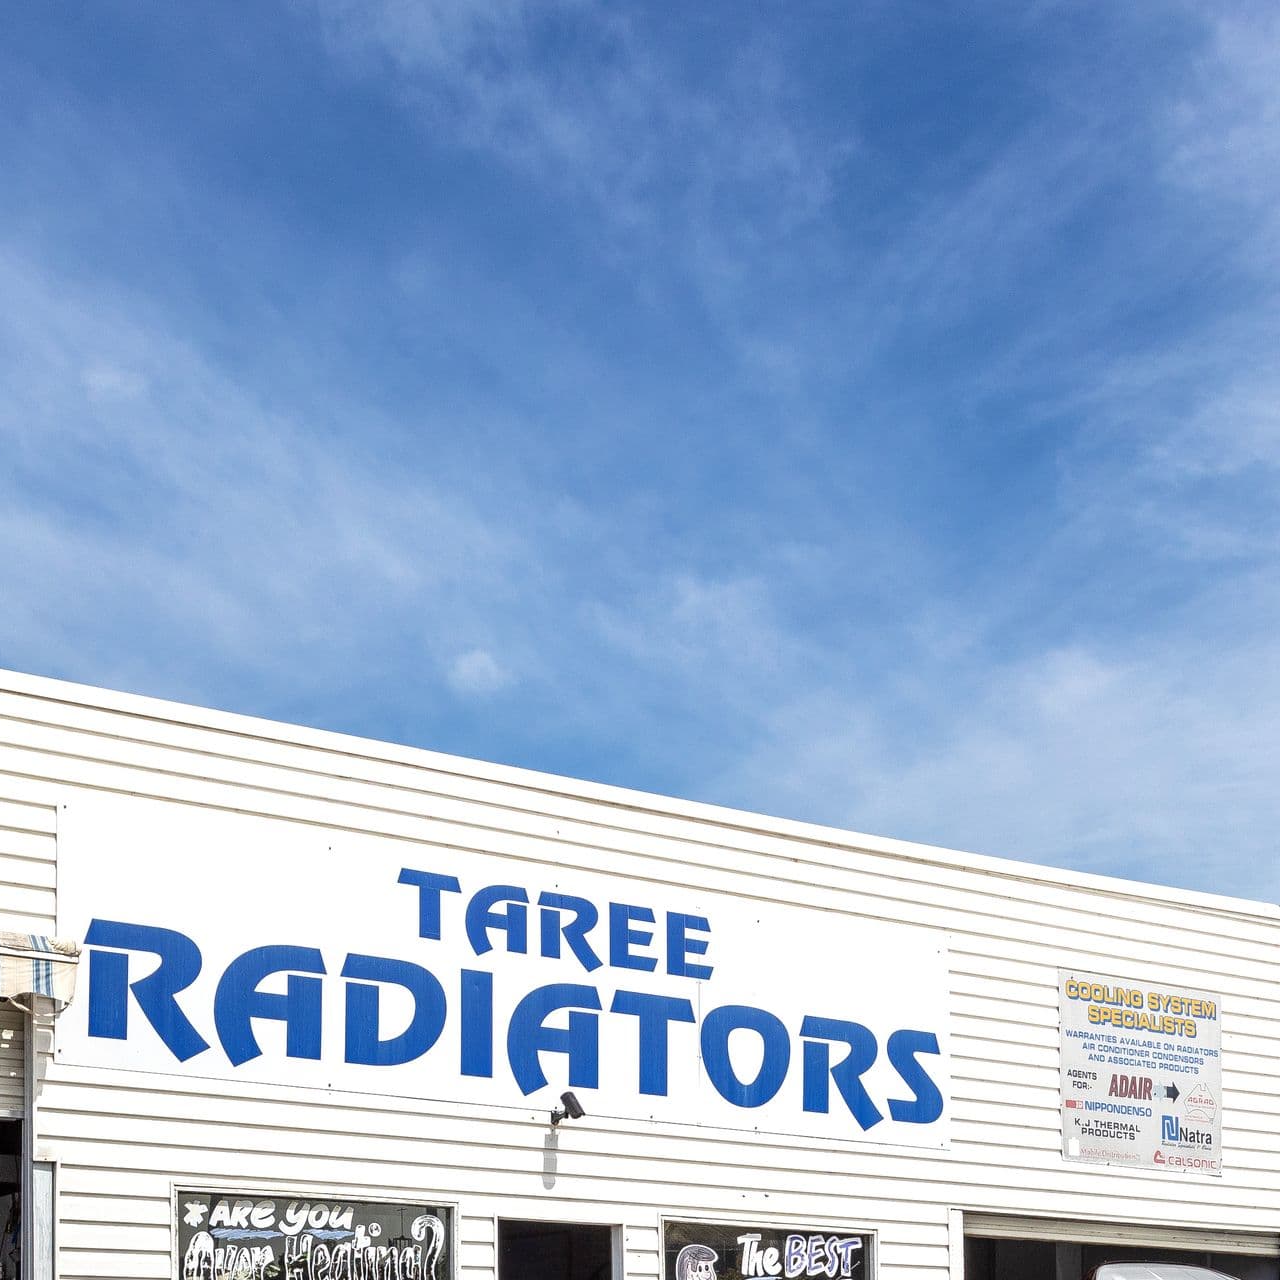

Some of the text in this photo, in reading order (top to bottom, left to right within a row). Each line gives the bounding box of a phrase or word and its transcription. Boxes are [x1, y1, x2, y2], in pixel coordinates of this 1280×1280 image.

[397, 868, 714, 979] TAREE
[1066, 980, 1216, 1020] COOLING SYSTEM
[84, 918, 943, 1131] RADIATORS
[1088, 1005, 1197, 1037] SPECIALISTS
[1065, 1029, 1219, 1057] WARRANTIES AVAILABLE ON RADIATORS
[1082, 1042, 1204, 1065] AIR CONDITIONER CONDENSORS
[1067, 1069, 1097, 1080] AGENTS
[1088, 1054, 1199, 1074] AND ASSOCIATED PRODUCTS
[1108, 1074, 1153, 1100] ADAIR
[1085, 1101, 1152, 1117] NIPPONDENSO
[1082, 1127, 1135, 1140] PRODUCTS
[1094, 1120, 1141, 1132] THERMAL
[1180, 1127, 1212, 1145] Natra
[785, 1234, 862, 1278] BEST
